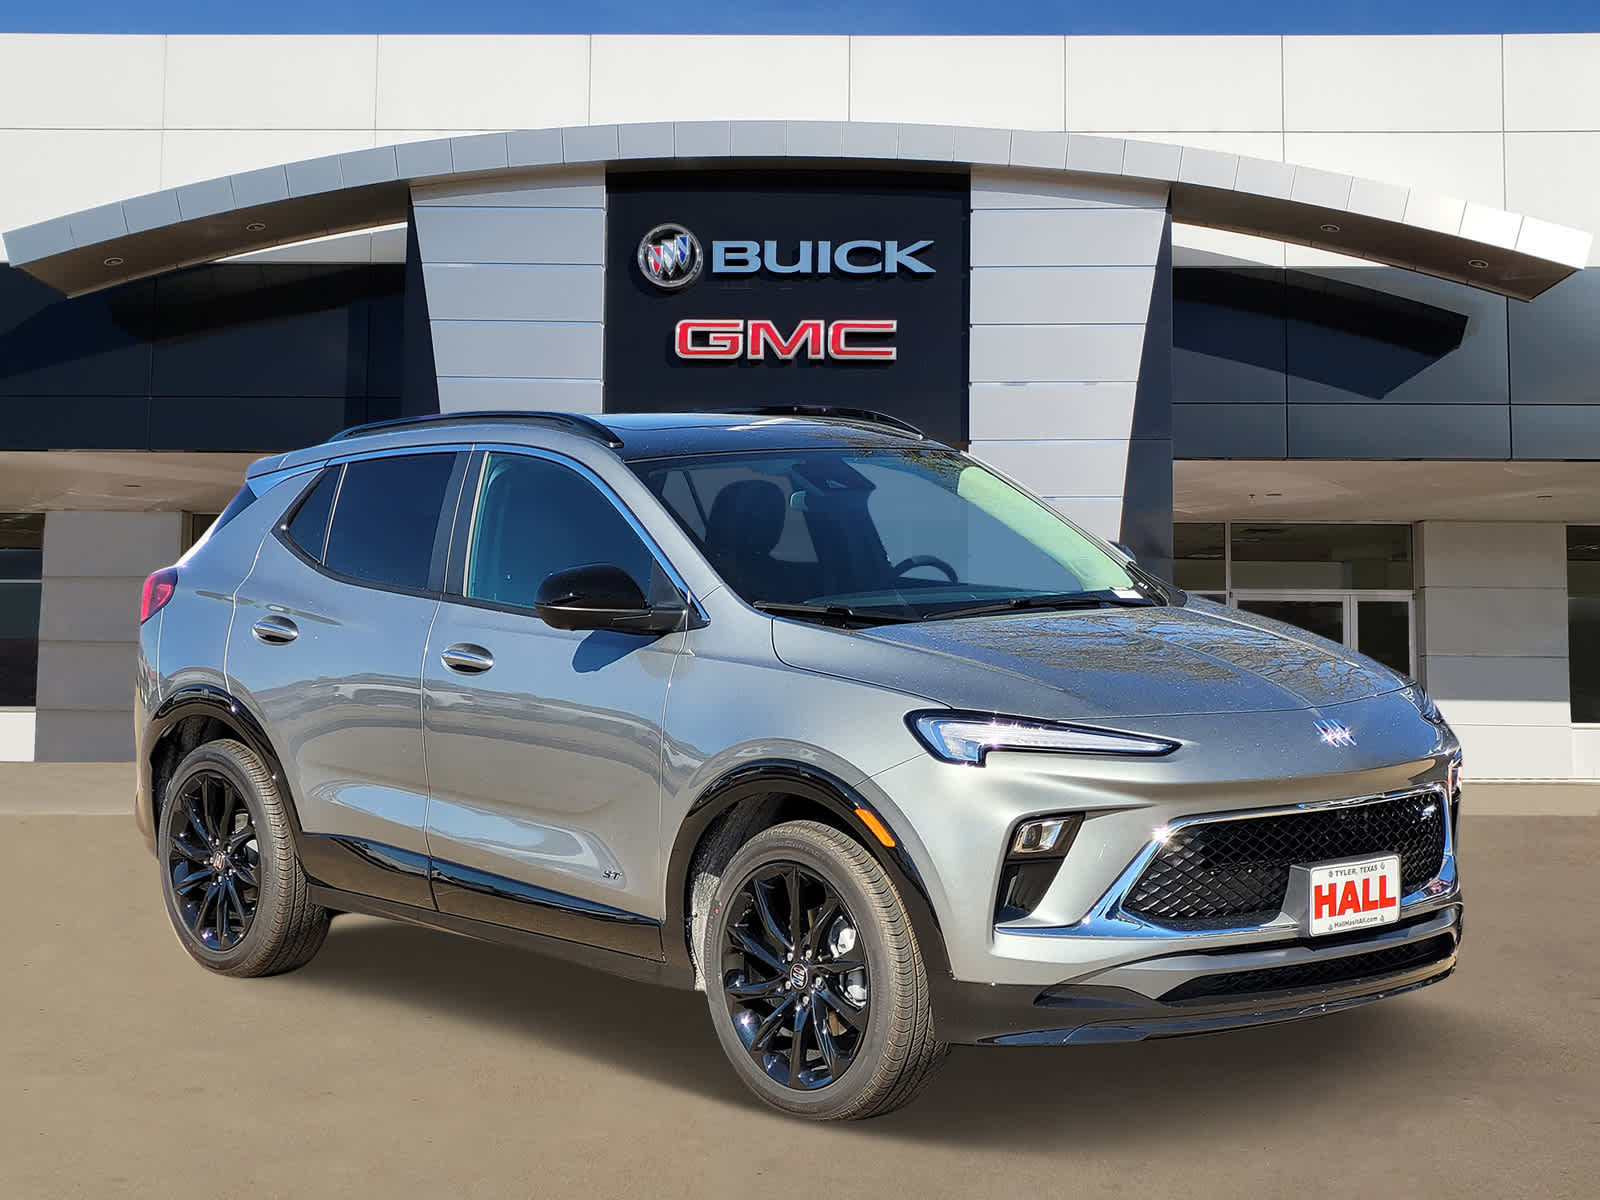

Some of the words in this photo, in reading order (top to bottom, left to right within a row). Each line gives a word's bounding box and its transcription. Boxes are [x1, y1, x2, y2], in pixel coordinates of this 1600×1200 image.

[711, 240, 936, 274] BUICK
[674, 319, 898, 361] GMC
[1360, 864, 1378, 873] TEXAS
[1314, 875, 1396, 919] HALL
